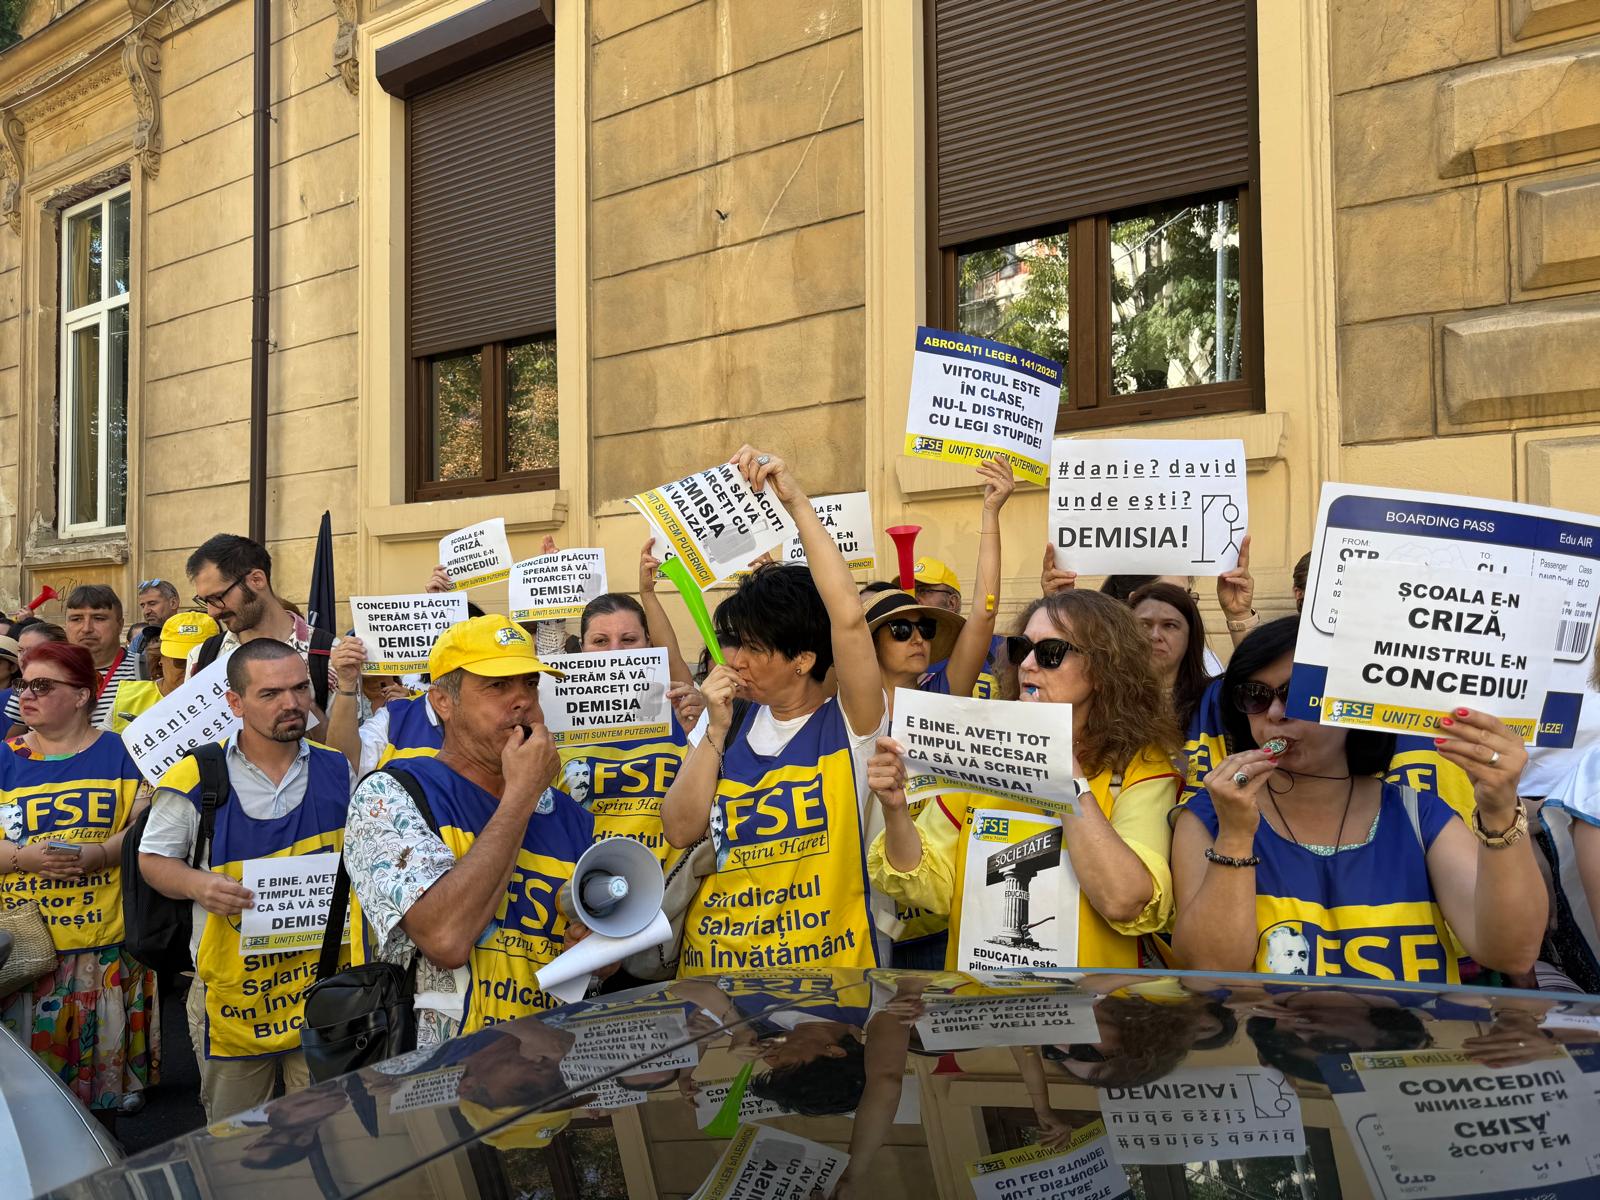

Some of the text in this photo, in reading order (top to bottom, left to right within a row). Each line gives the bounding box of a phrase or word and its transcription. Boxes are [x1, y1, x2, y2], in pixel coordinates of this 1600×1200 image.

[924, 337, 1058, 379] ABROGAȚI LEGEA 141/2025!
[943, 363, 1041, 397] VIITORUL ESTE
[960, 381, 1025, 411] ÎN CLASE,
[932, 396, 1043, 434] NU-L DISTRUGEȚI
[929, 413, 1042, 449] CU LEGI STUPIDE!
[922, 439, 943, 450] FSE
[948, 444, 973, 459] UNIȚI
[1058, 459, 1236, 479] #danie? david
[679, 476, 725, 538] EMISIA
[729, 484, 761, 524] SĂ VĂ
[826, 504, 842, 512] E-N
[1057, 492, 1119, 510] unde
[655, 504, 682, 537] SUNTEM
[670, 490, 708, 541] VALIZĂ!
[1386, 512, 1496, 533] BOARDING PASS
[473, 530, 485, 539] E-N
[733, 516, 749, 535] CU
[837, 531, 853, 539] E-N
[1058, 525, 1188, 549] DEMISIA!
[1560, 533, 1592, 547] Edu AIR
[446, 556, 499, 577] CONCEDIU!
[447, 549, 494, 566] MINISTRUL E-N
[517, 553, 599, 568] CONCEDIU PLĂCUT!
[1540, 558, 1592, 574] Passenger Class
[523, 563, 588, 575] SPERĂM SĂ VĂ
[522, 575, 576, 584] ÎNTOARCEȚI
[1577, 579, 1589, 588] ECO
[530, 585, 585, 596] DEMISIA
[547, 595, 581, 604] VALIZĂ!
[1398, 582, 1520, 609] ȘCOALA E-N
[357, 599, 460, 609] CONCEDIU PLĂCUT!
[368, 610, 446, 622] SPERĂM SĂ VĂ
[1408, 607, 1506, 642] CRIZĂ,
[369, 622, 431, 632] ÎNTOARCEȚI
[611, 656, 661, 667] PLĂCUT!
[1373, 641, 1528, 670] MINISTRUL E-N
[610, 670, 628, 680] SĂ
[630, 671, 646, 679] VĂ
[1362, 662, 1528, 700] CONCEDIU!
[555, 683, 650, 696] ÎNTOARCEȚI CU
[566, 698, 641, 714] DEMISIA
[572, 714, 635, 726] ÎN VALIZĂ!
[1342, 702, 1374, 717] FSE
[1382, 710, 1420, 729] UNIȚI
[570, 732, 590, 743] UNIȚI
[592, 730, 622, 738] SUNTEM
[624, 727, 666, 736] PUTERNICI!
[906, 716, 1050, 747] E BINE. AVEȚI TOT
[908, 733, 1047, 764] TIMPUL NECESAR
[908, 749, 1049, 781] CA SĂ VĂ SCRIEȚI
[594, 756, 678, 794] FSE
[930, 766, 1033, 794] DEMISIA!
[26, 792, 111, 831] FSE
[594, 800, 634, 814] Spiru
[725, 780, 824, 841] FSE
[983, 819, 1008, 834] FSE
[731, 834, 826, 865] Spiru Haret
[995, 834, 1052, 867] SOCIETATE
[257, 879, 265, 888] E
[269, 876, 302, 887] BINE.
[83, 892, 94, 905] 5
[258, 890, 305, 900] TIMPUL
[704, 874, 821, 909] Sindicatul
[257, 904, 275, 913] CA
[278, 900, 295, 911] SĂ
[299, 898, 314, 909] VĂ
[698, 909, 831, 939] Salariaților
[274, 936, 294, 944] UNIȚI
[973, 947, 1058, 968] EDUCAȚIA este
[221, 1004, 256, 1020] din
